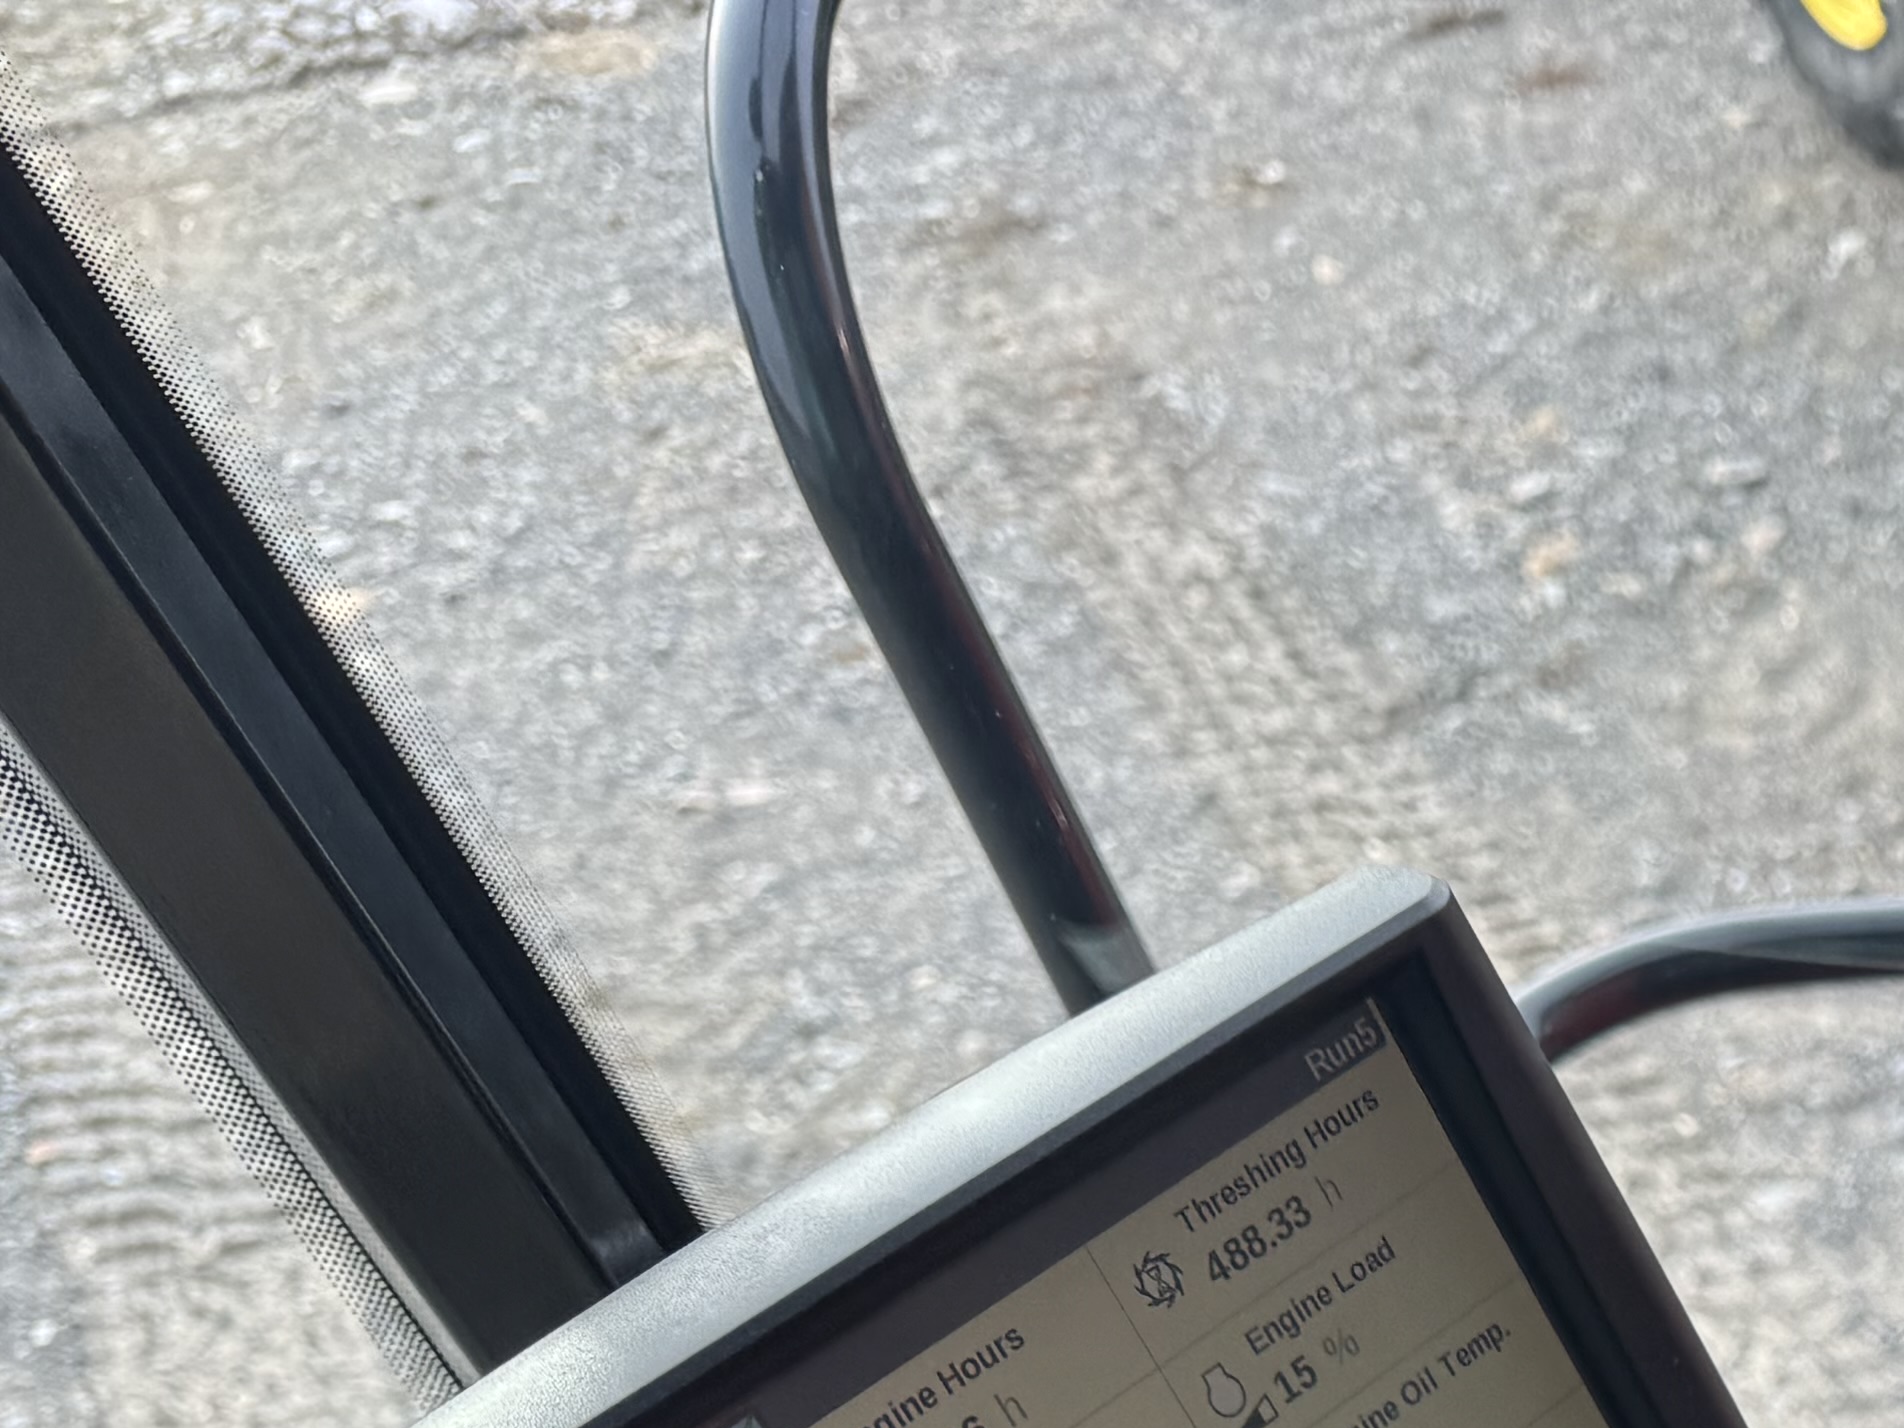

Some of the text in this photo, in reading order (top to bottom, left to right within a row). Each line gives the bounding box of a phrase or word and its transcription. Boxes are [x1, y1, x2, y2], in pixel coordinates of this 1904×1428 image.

[1304, 1016, 1381, 1082] Run5
[1174, 1088, 1381, 1234] Threshing Hours
[1205, 1176, 1343, 1282] 488.33 h
[1244, 1235, 1397, 1356] Engine Load
[937, 1328, 1026, 1395] Hours
[1273, 1328, 1361, 1404] 15 %
[1400, 1370, 1439, 1407] Oil
[1438, 1320, 1512, 1379] Temp.
[994, 1393, 1029, 1428] h
